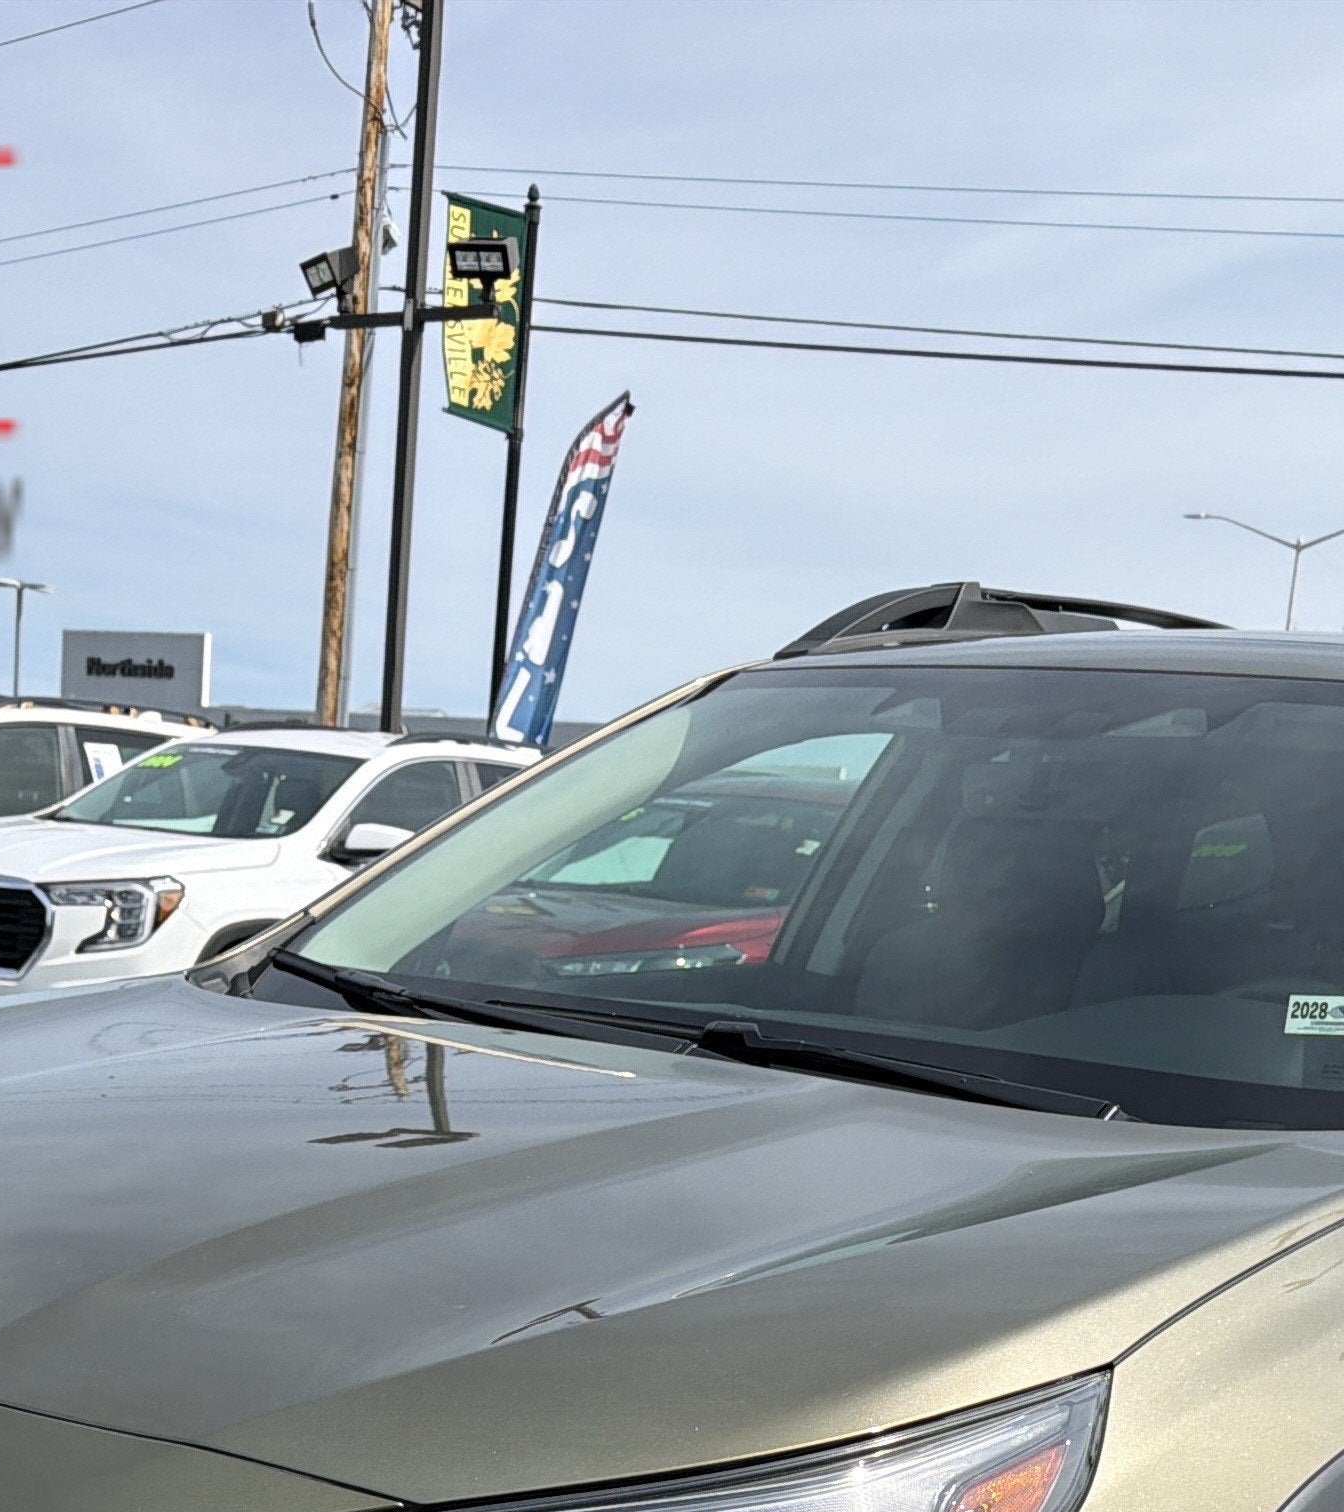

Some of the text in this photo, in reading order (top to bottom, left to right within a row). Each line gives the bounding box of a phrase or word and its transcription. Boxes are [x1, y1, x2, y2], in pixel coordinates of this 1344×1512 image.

[445, 209, 468, 399] SUESVILLE
[85, 656, 176, 680] Northside
[1290, 1001, 1329, 1020] 2028
